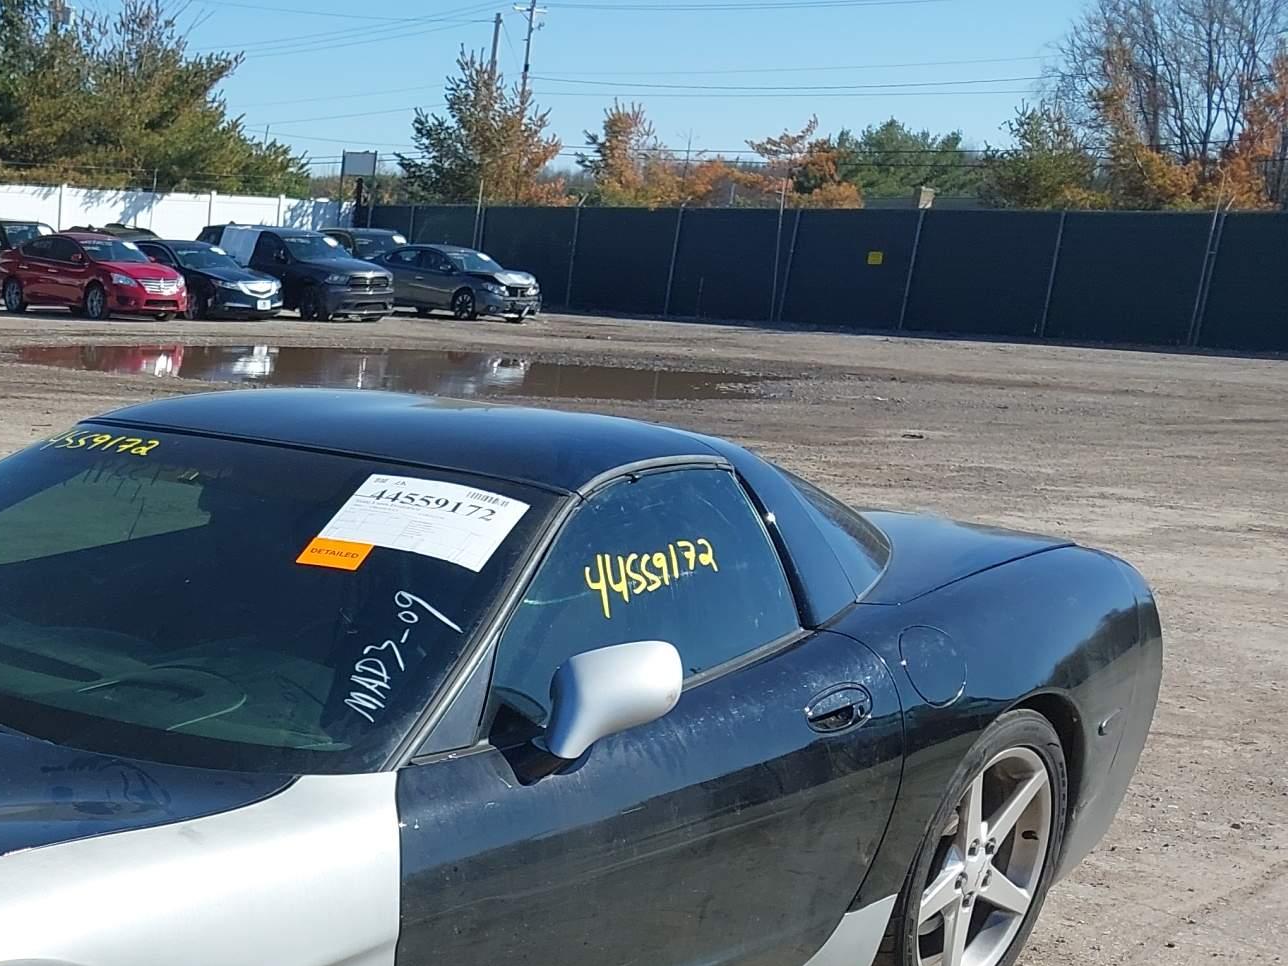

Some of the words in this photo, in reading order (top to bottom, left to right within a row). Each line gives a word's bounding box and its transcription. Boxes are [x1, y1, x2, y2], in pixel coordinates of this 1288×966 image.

[40, 430, 160, 456] 4559172
[370, 488, 497, 522] 44559172
[310, 547, 360, 559] DETAILED
[584, 538, 719, 619] 44559172
